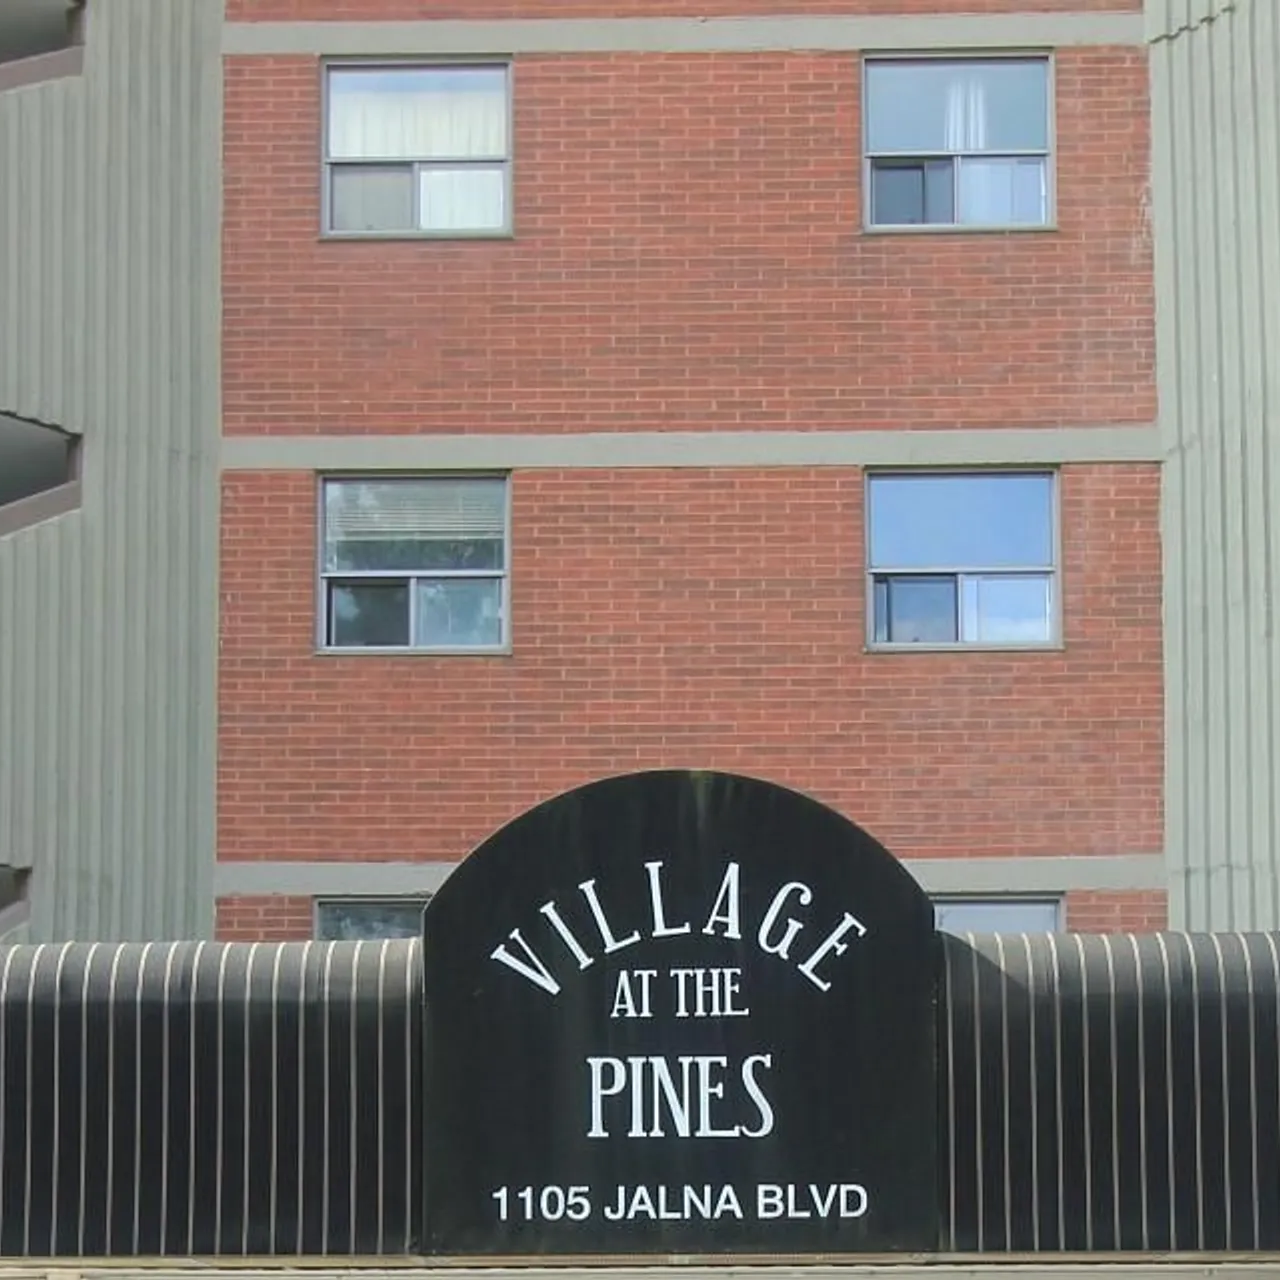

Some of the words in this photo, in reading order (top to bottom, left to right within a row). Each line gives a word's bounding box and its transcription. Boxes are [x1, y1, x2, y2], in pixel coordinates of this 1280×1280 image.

[490, 861, 867, 995] VILLAGE
[610, 969, 658, 1018] AT
[669, 967, 750, 1018] THE
[586, 1053, 774, 1138] PINES
[492, 1185, 592, 1221] 1105
[603, 1184, 744, 1221] JALNA
[757, 1183, 868, 1219] BLVD
